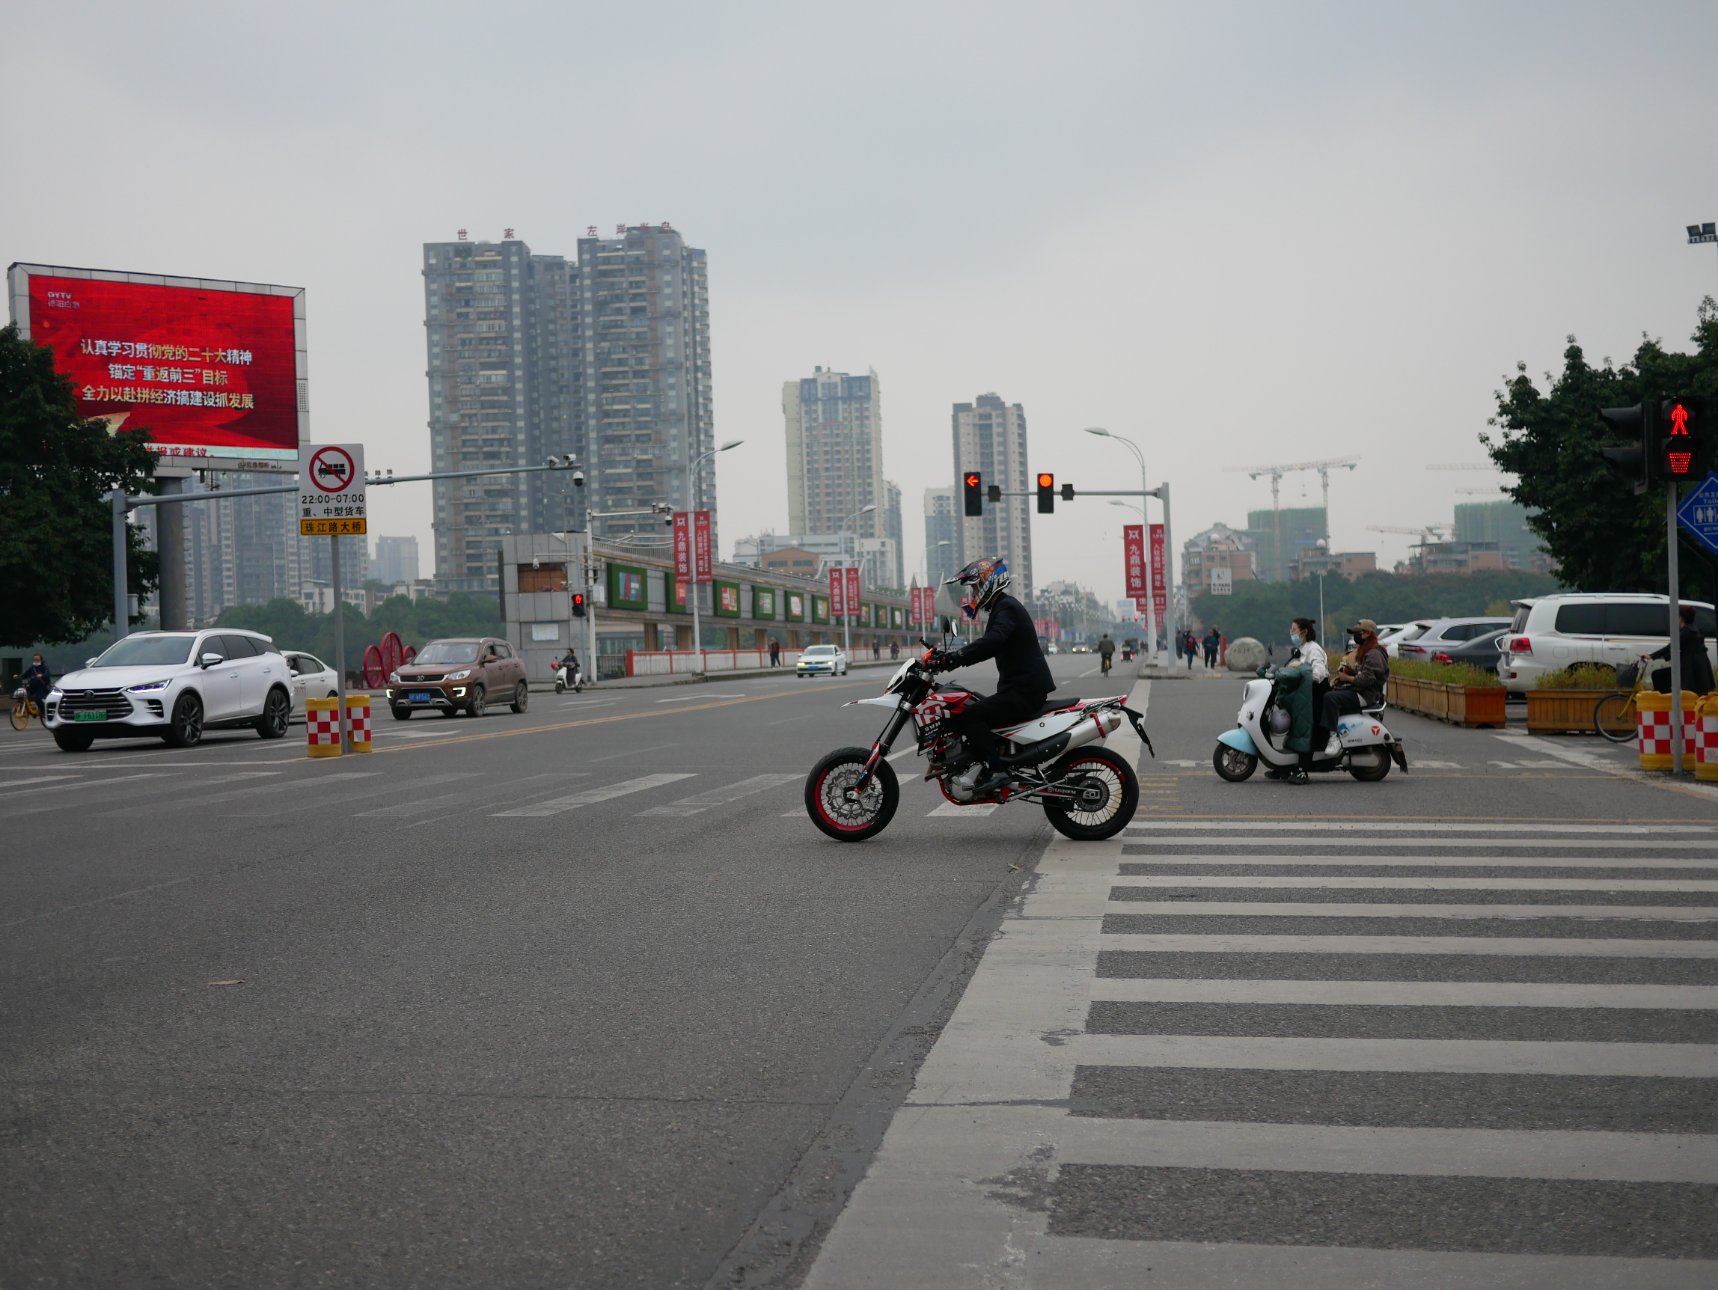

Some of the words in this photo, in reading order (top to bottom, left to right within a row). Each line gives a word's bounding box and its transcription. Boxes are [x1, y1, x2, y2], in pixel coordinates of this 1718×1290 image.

[80, 338, 252, 366] 认真学习贯彻党的二十大精神
[81, 384, 254, 409] 全力以赴拼经济搞建设抓发展
[301, 494, 365, 504] 22:00-07:00
[302, 506, 365, 517] 重、中型货车
[304, 521, 362, 533] 珠江路大桥
